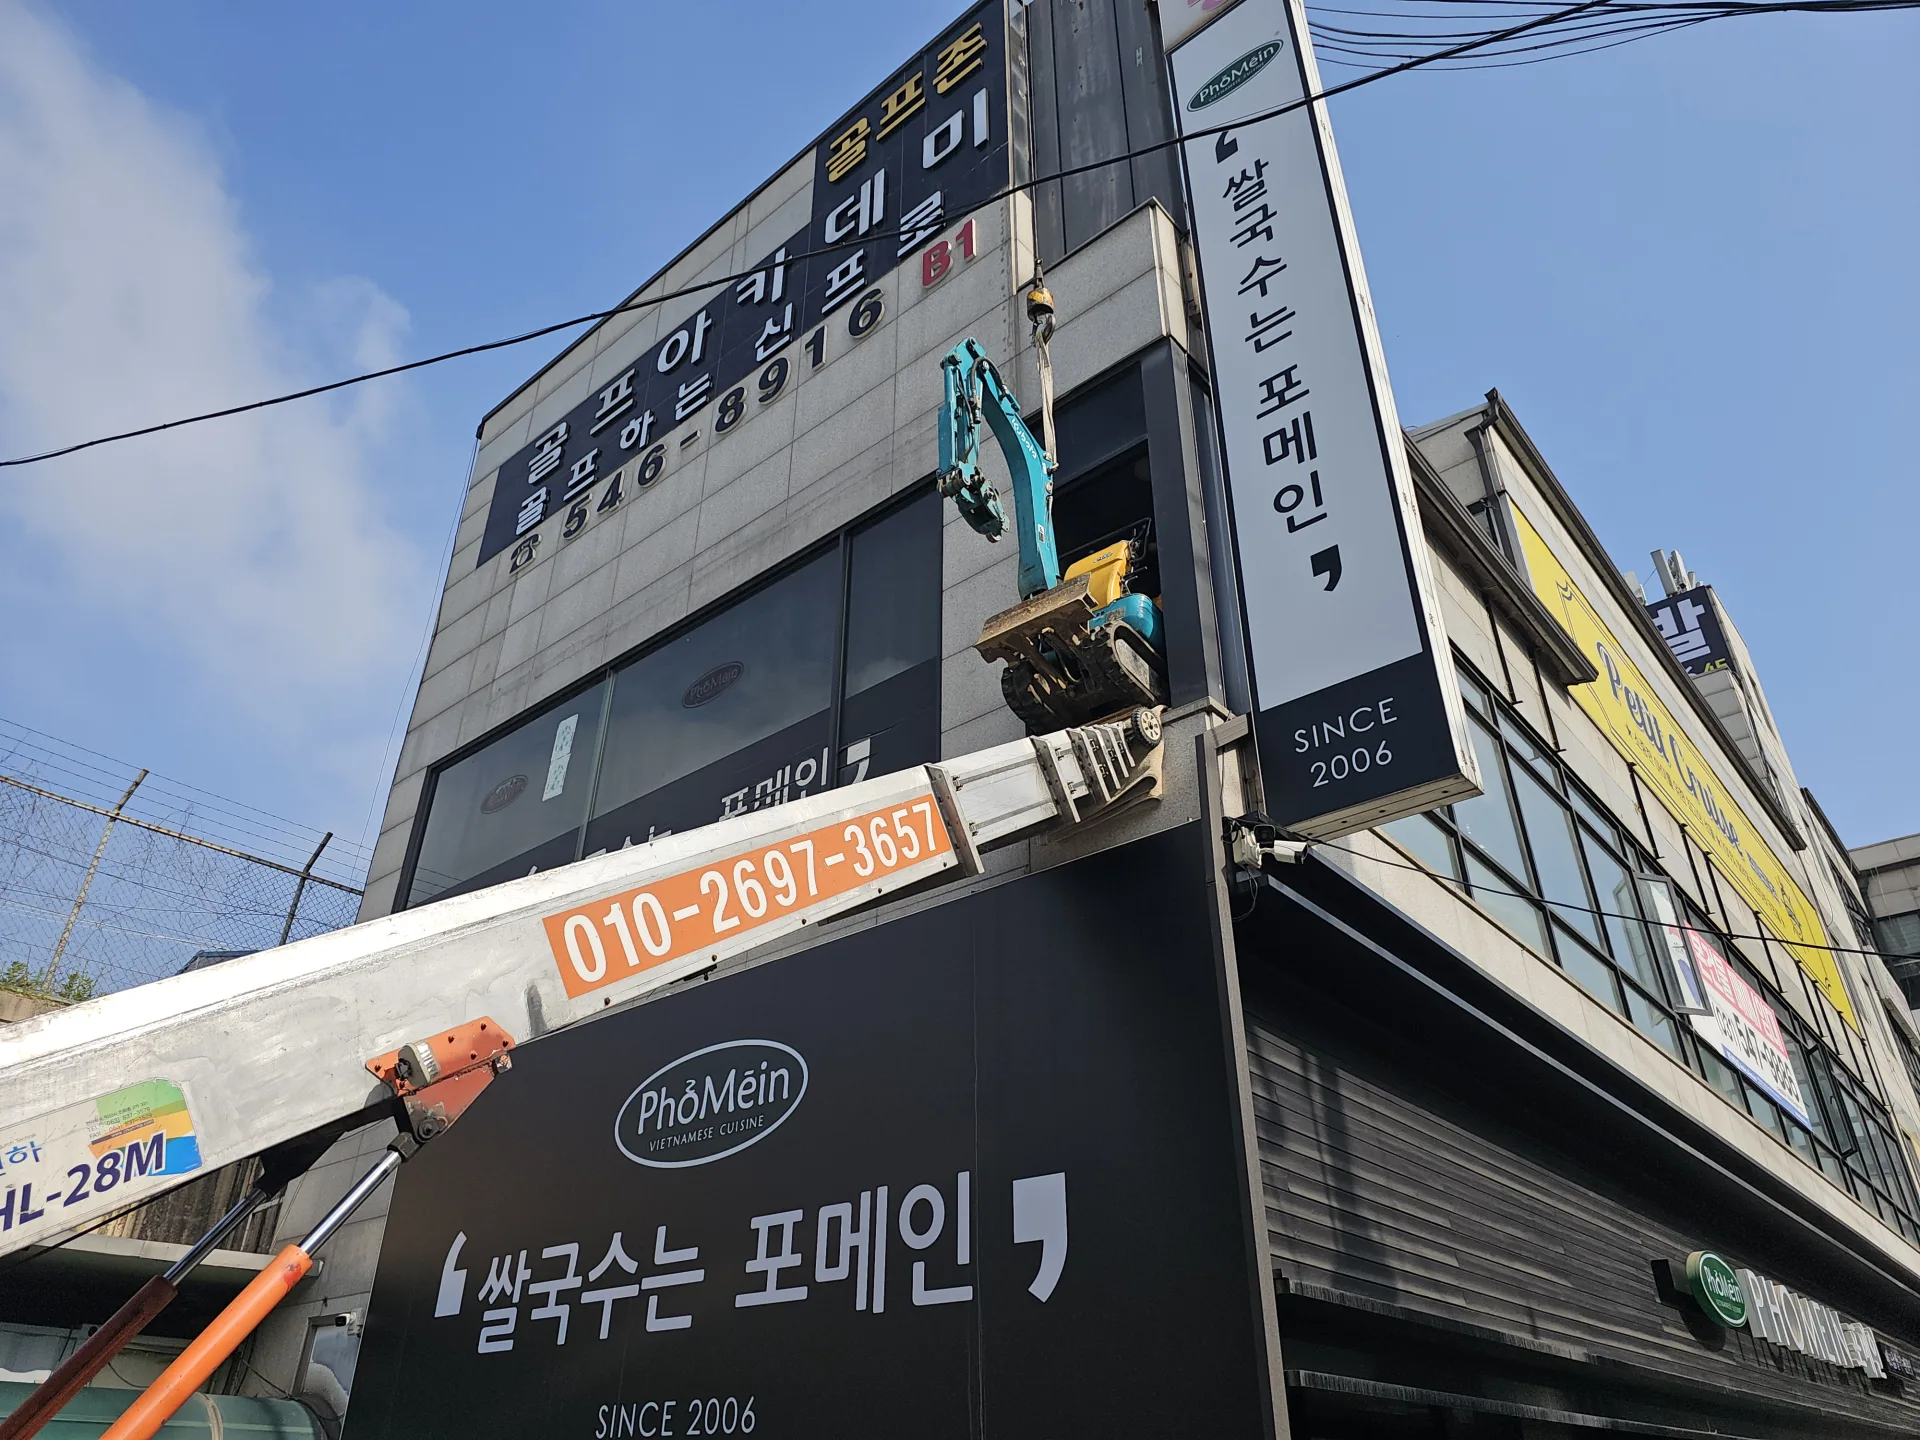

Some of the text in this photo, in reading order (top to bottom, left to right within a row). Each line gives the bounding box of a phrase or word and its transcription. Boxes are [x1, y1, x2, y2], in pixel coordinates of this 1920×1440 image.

[825, 22, 988, 183] 골프존
[922, 218, 977, 289] B1
[1294, 697, 1399, 755] SINCE
[1597, 641, 1672, 768] Petit
[1668, 733, 1745, 860] Cruise
[1310, 740, 1394, 788] 2006
[562, 801, 939, 983] 010-2697-3657
[0, 1140, 42, 1176] 하
[649, 1115, 765, 1152] VIETNAMESE CUISINE
[1743, 1268, 1856, 1369] PHOMEIN
[594, 1395, 757, 1440] SINCE 2006
